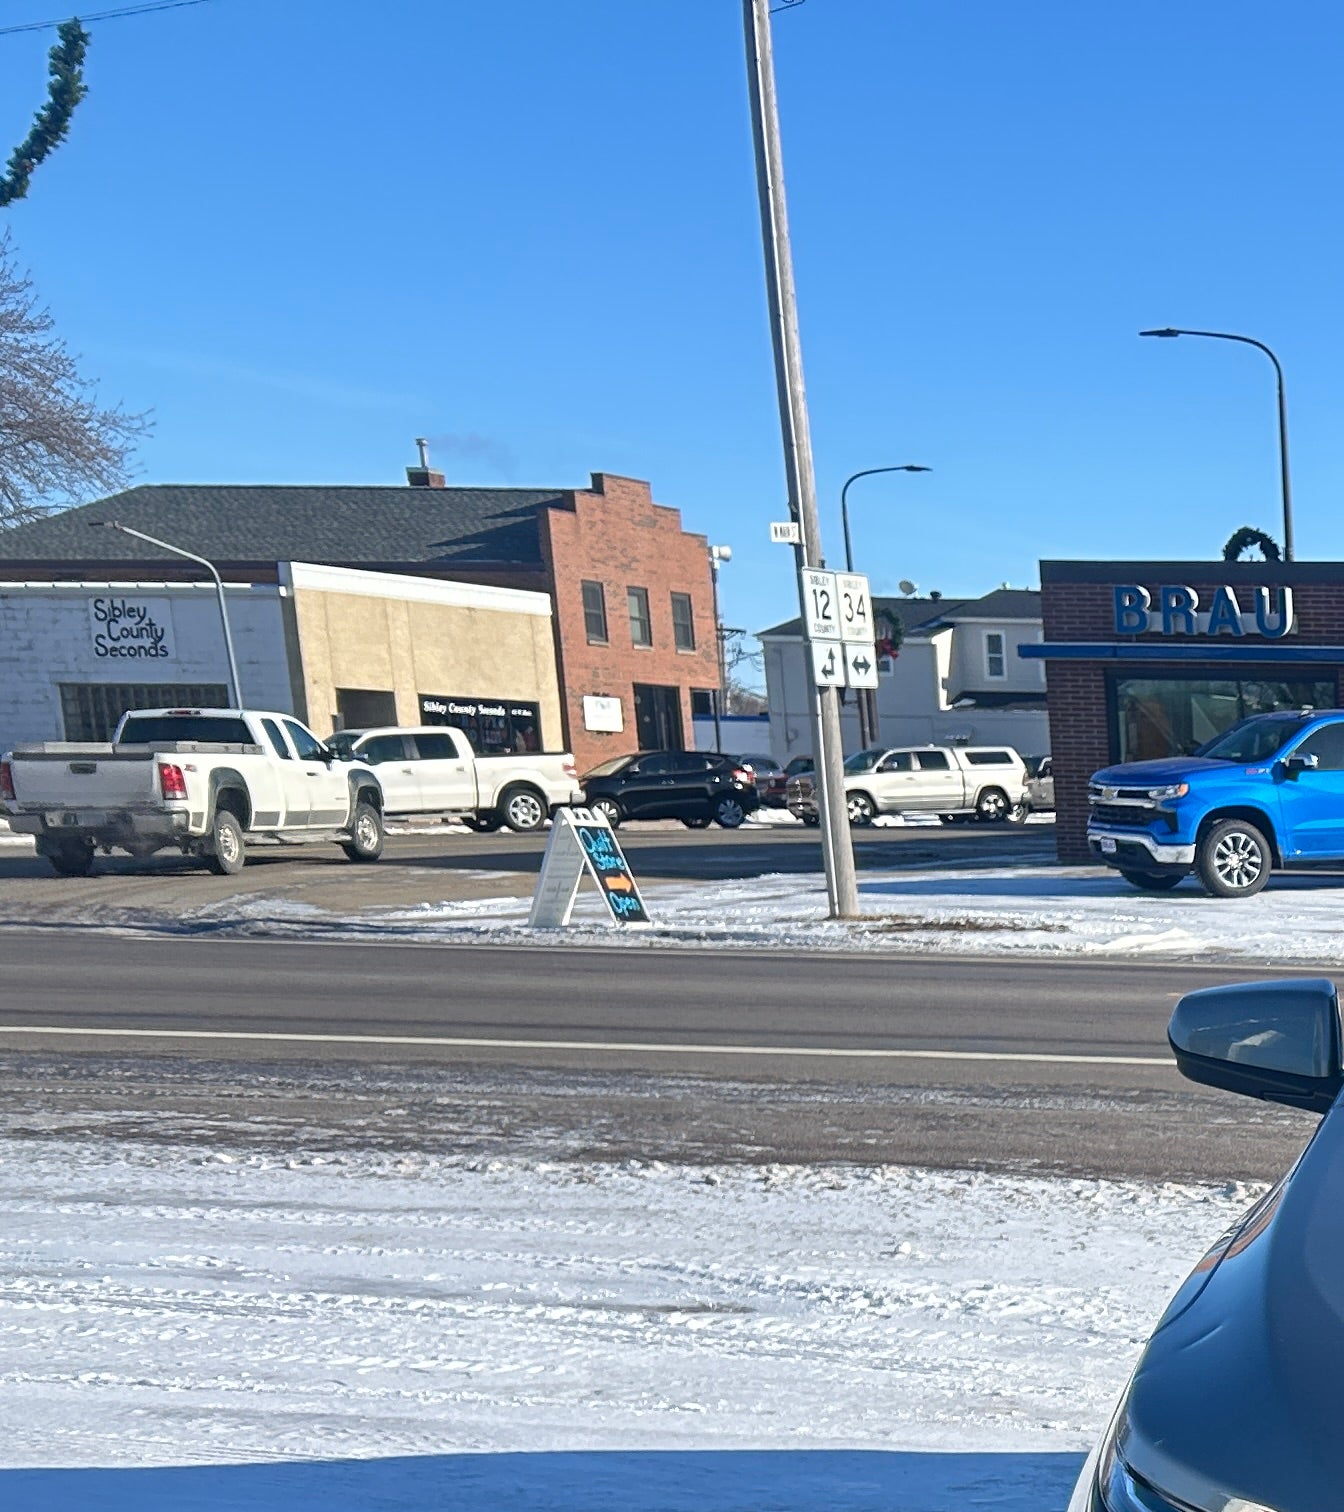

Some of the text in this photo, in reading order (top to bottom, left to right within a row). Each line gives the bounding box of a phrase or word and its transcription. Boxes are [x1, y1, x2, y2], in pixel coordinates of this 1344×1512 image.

[94, 598, 147, 625] Sibley
[813, 588, 832, 620] 12
[844, 592, 867, 622] 34
[1113, 585, 1294, 638] BRAU
[107, 617, 165, 644] County
[94, 634, 169, 657] Seconds
[423, 700, 447, 715] Sibley
[448, 702, 477, 717] County
[609, 891, 640, 917] Open
